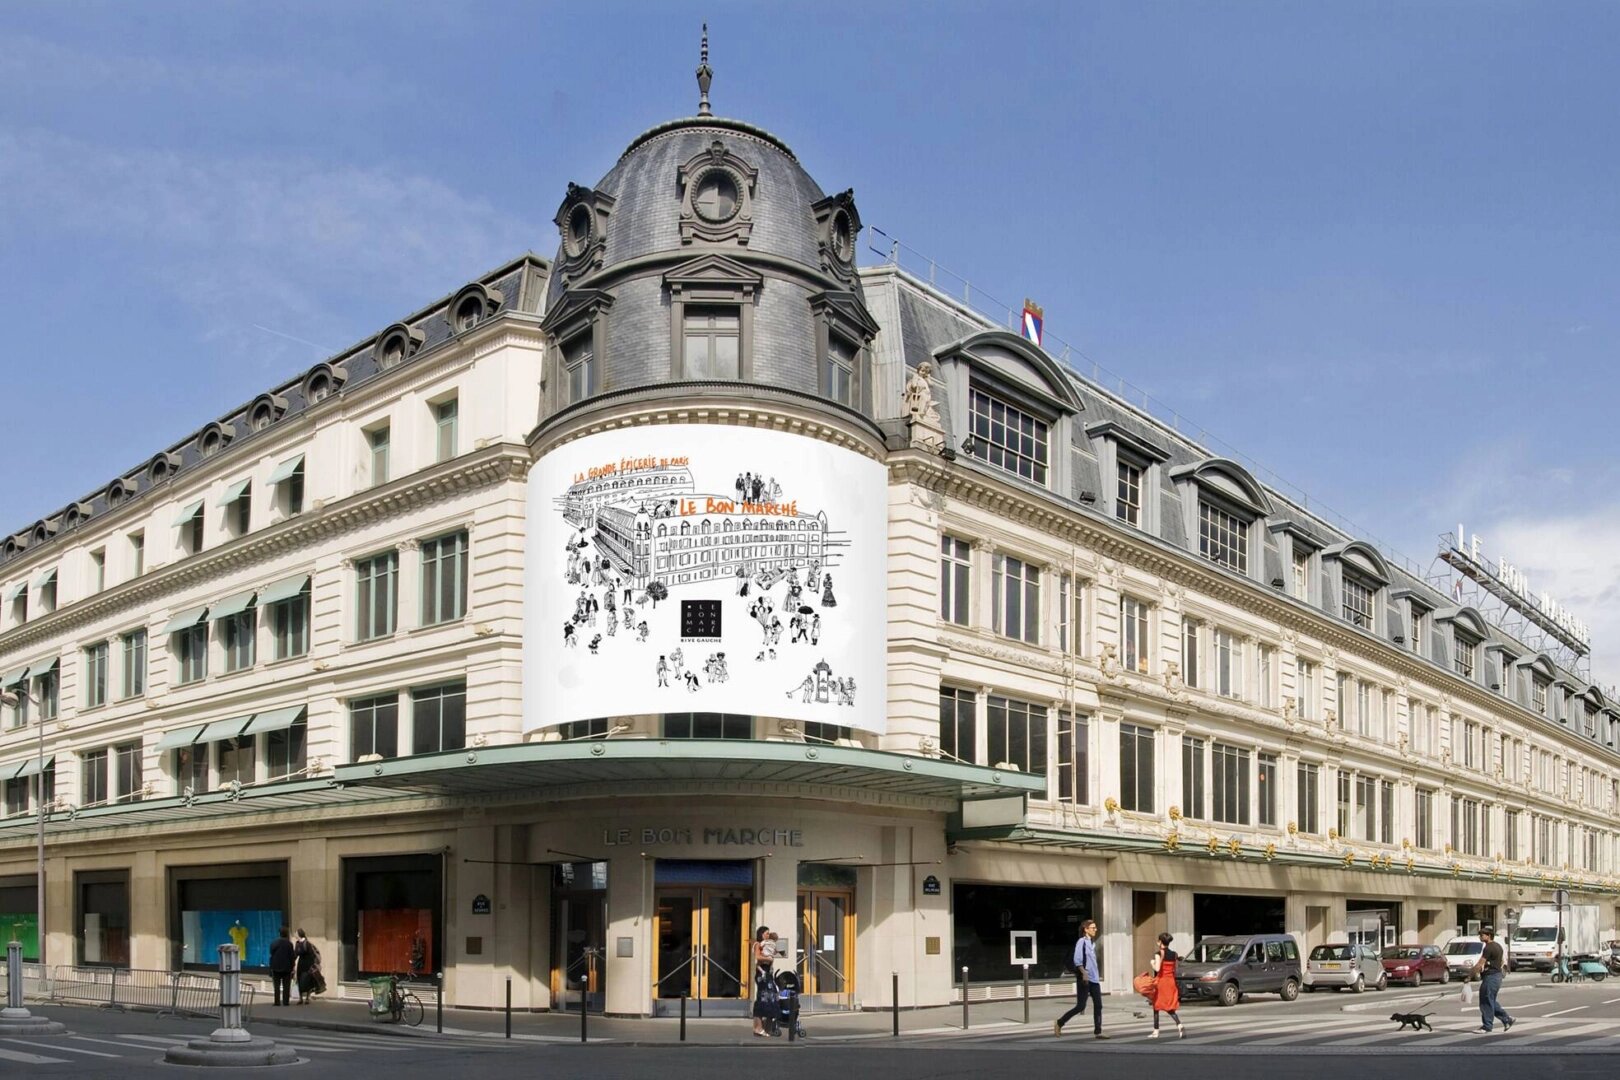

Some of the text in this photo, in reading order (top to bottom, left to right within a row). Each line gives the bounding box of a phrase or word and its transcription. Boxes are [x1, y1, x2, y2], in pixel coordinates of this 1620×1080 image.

[574, 473, 584, 484] LA
[588, 463, 616, 480] GRANDE
[660, 458, 668, 467] DE
[671, 456, 689, 466] PARIS
[680, 497, 798, 517] LE BON MARCHÉ
[1458, 523, 1483, 566] LE
[603, 827, 804, 848] LE BON MARCHE
